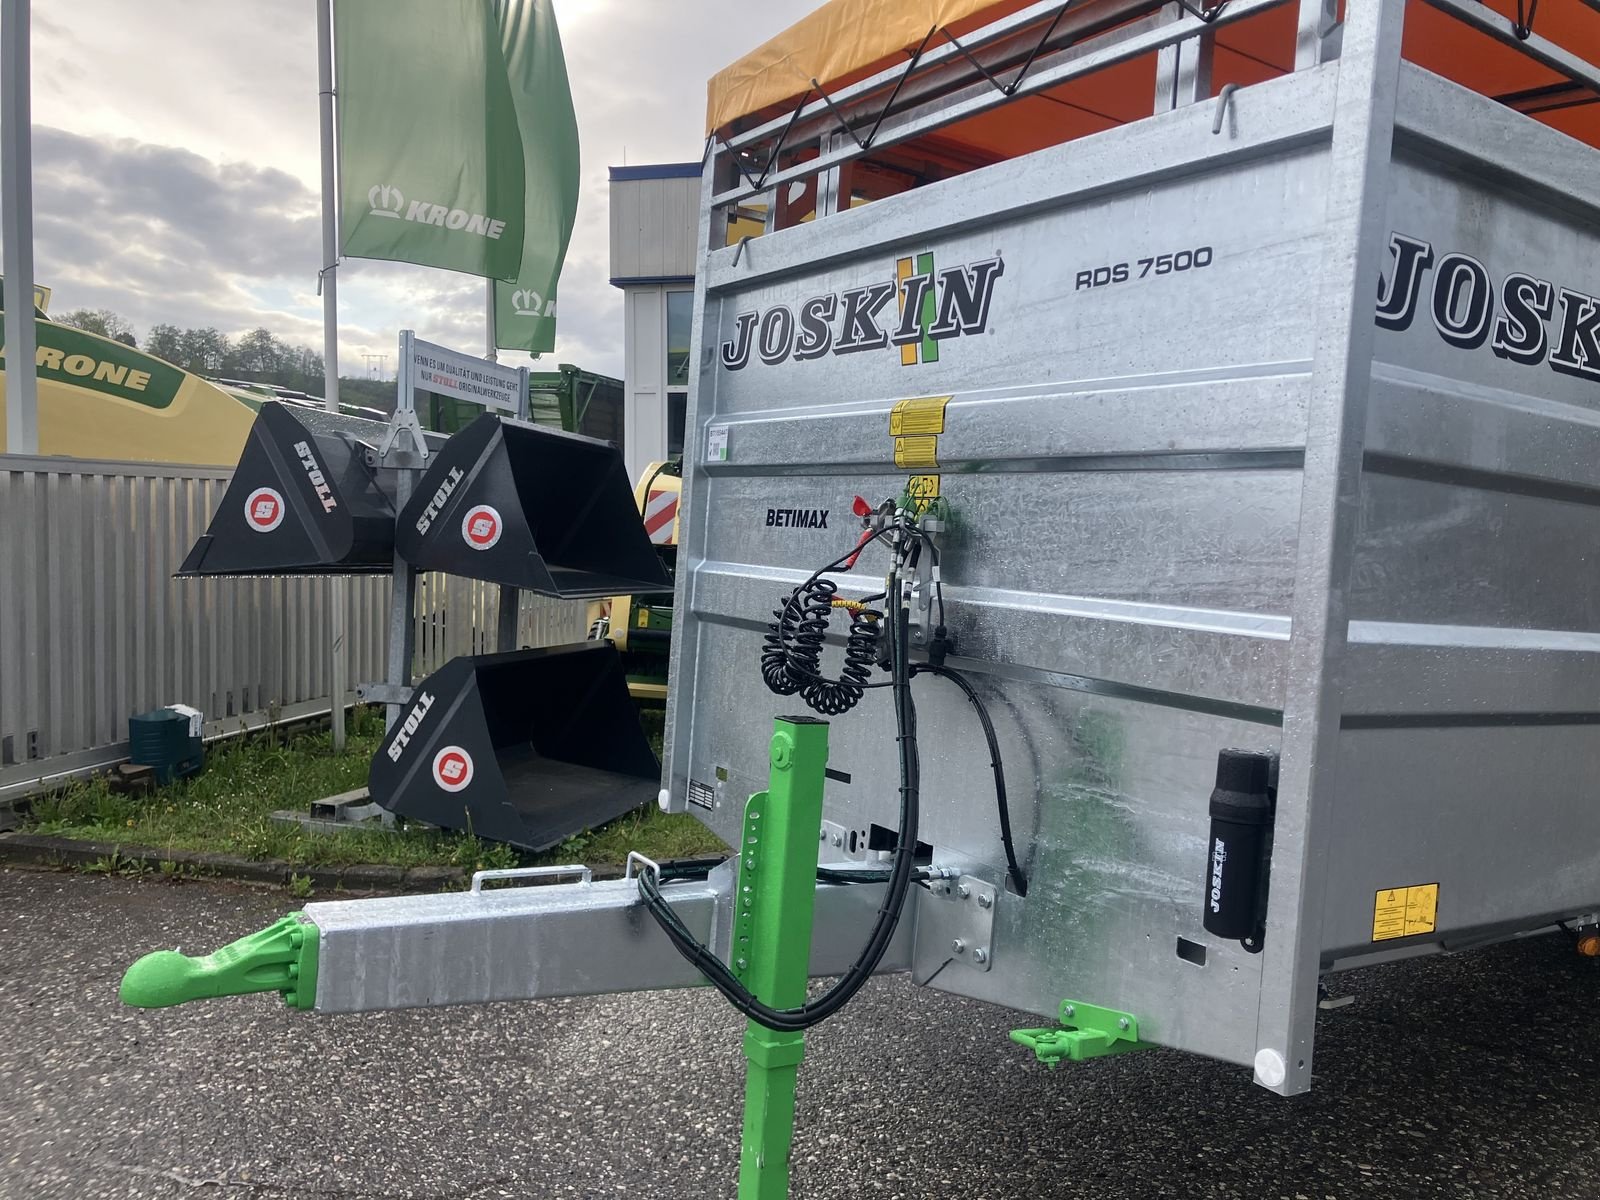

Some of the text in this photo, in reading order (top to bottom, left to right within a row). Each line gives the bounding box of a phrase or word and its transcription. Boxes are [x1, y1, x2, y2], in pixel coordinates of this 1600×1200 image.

[405, 200, 506, 240] KRONE
[1075, 246, 1213, 290] RDS 7500
[722, 257, 1005, 371] JOSKIN
[36, 345, 151, 391] RONE
[421, 369, 433, 381] NUR
[432, 373, 458, 389] STOLL
[429, 358, 437, 369] ES
[437, 361, 446, 373] UM
[470, 371, 483, 382] UND
[483, 375, 506, 388] LEISTUNG
[294, 440, 337, 513] STOLL
[416, 466, 464, 536] STOLL
[766, 508, 830, 529] BETIMAX
[387, 691, 435, 763] STOLL
[1211, 837, 1226, 913] JOSKIN
